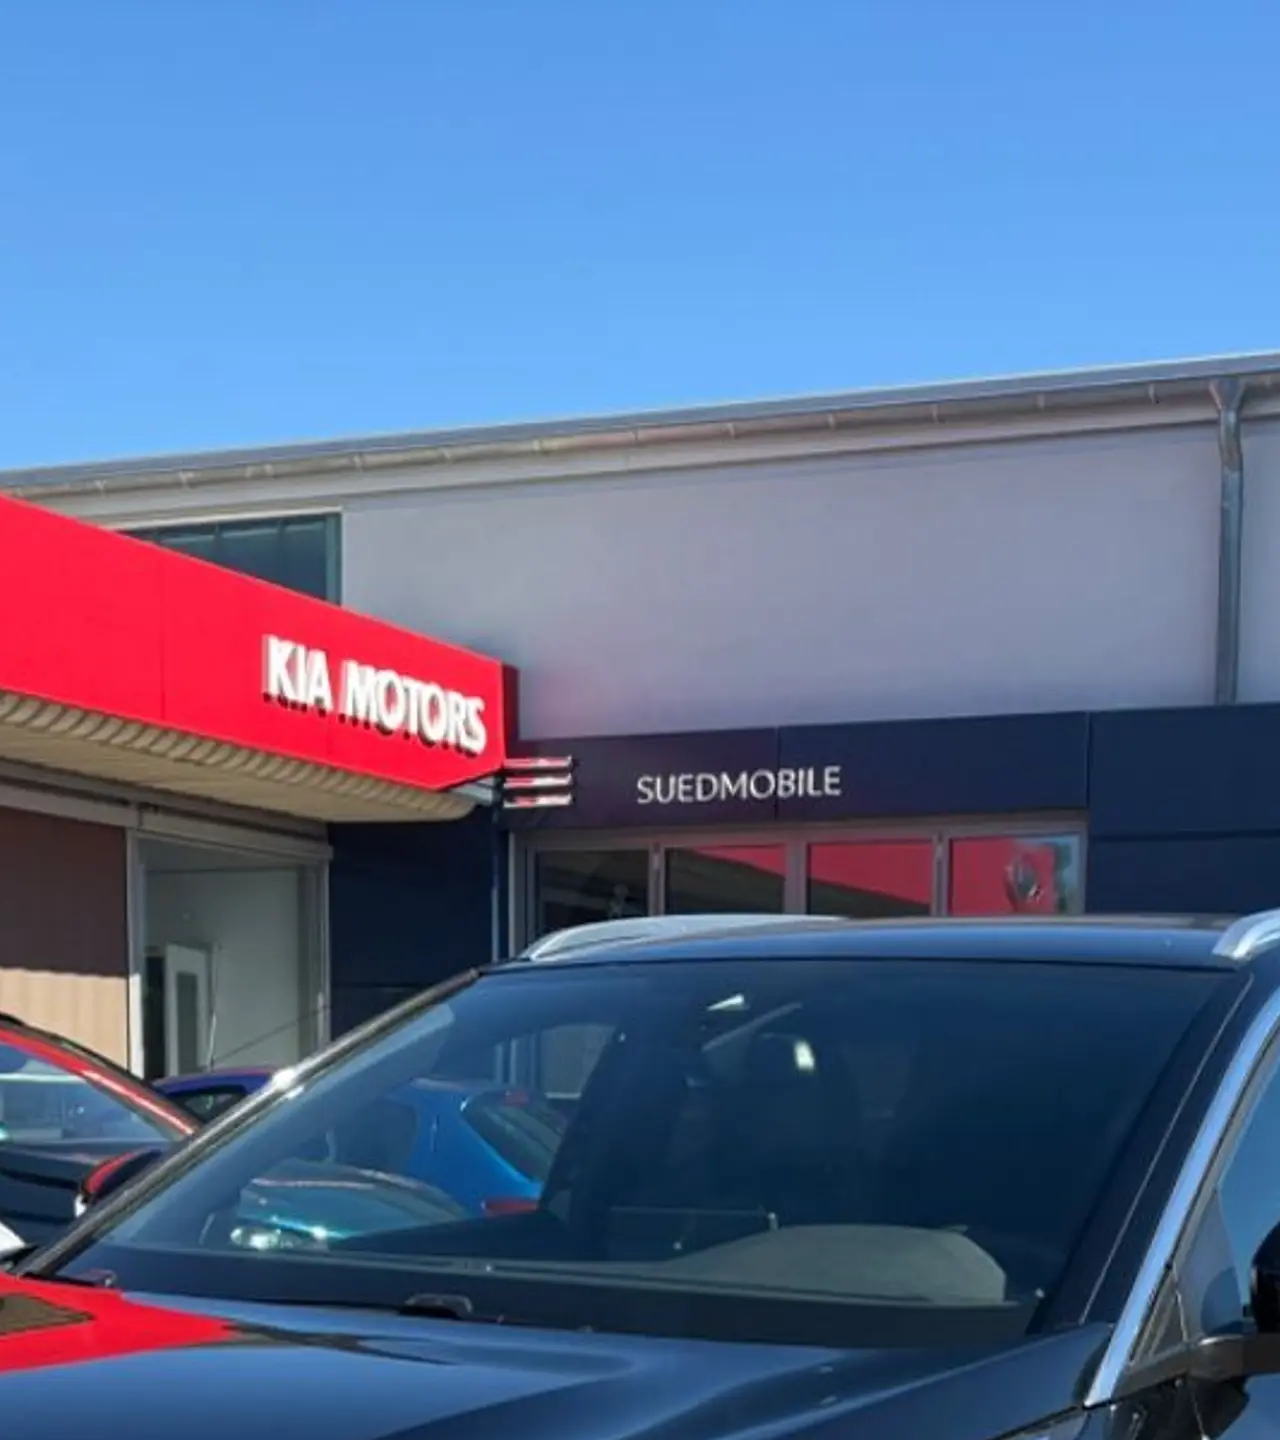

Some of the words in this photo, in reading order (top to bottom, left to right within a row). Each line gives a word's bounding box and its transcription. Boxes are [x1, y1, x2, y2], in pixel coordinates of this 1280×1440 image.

[263, 633, 333, 714] KIA
[339, 659, 488, 756] MOTORS
[636, 765, 842, 805] SUEDMOBILE
